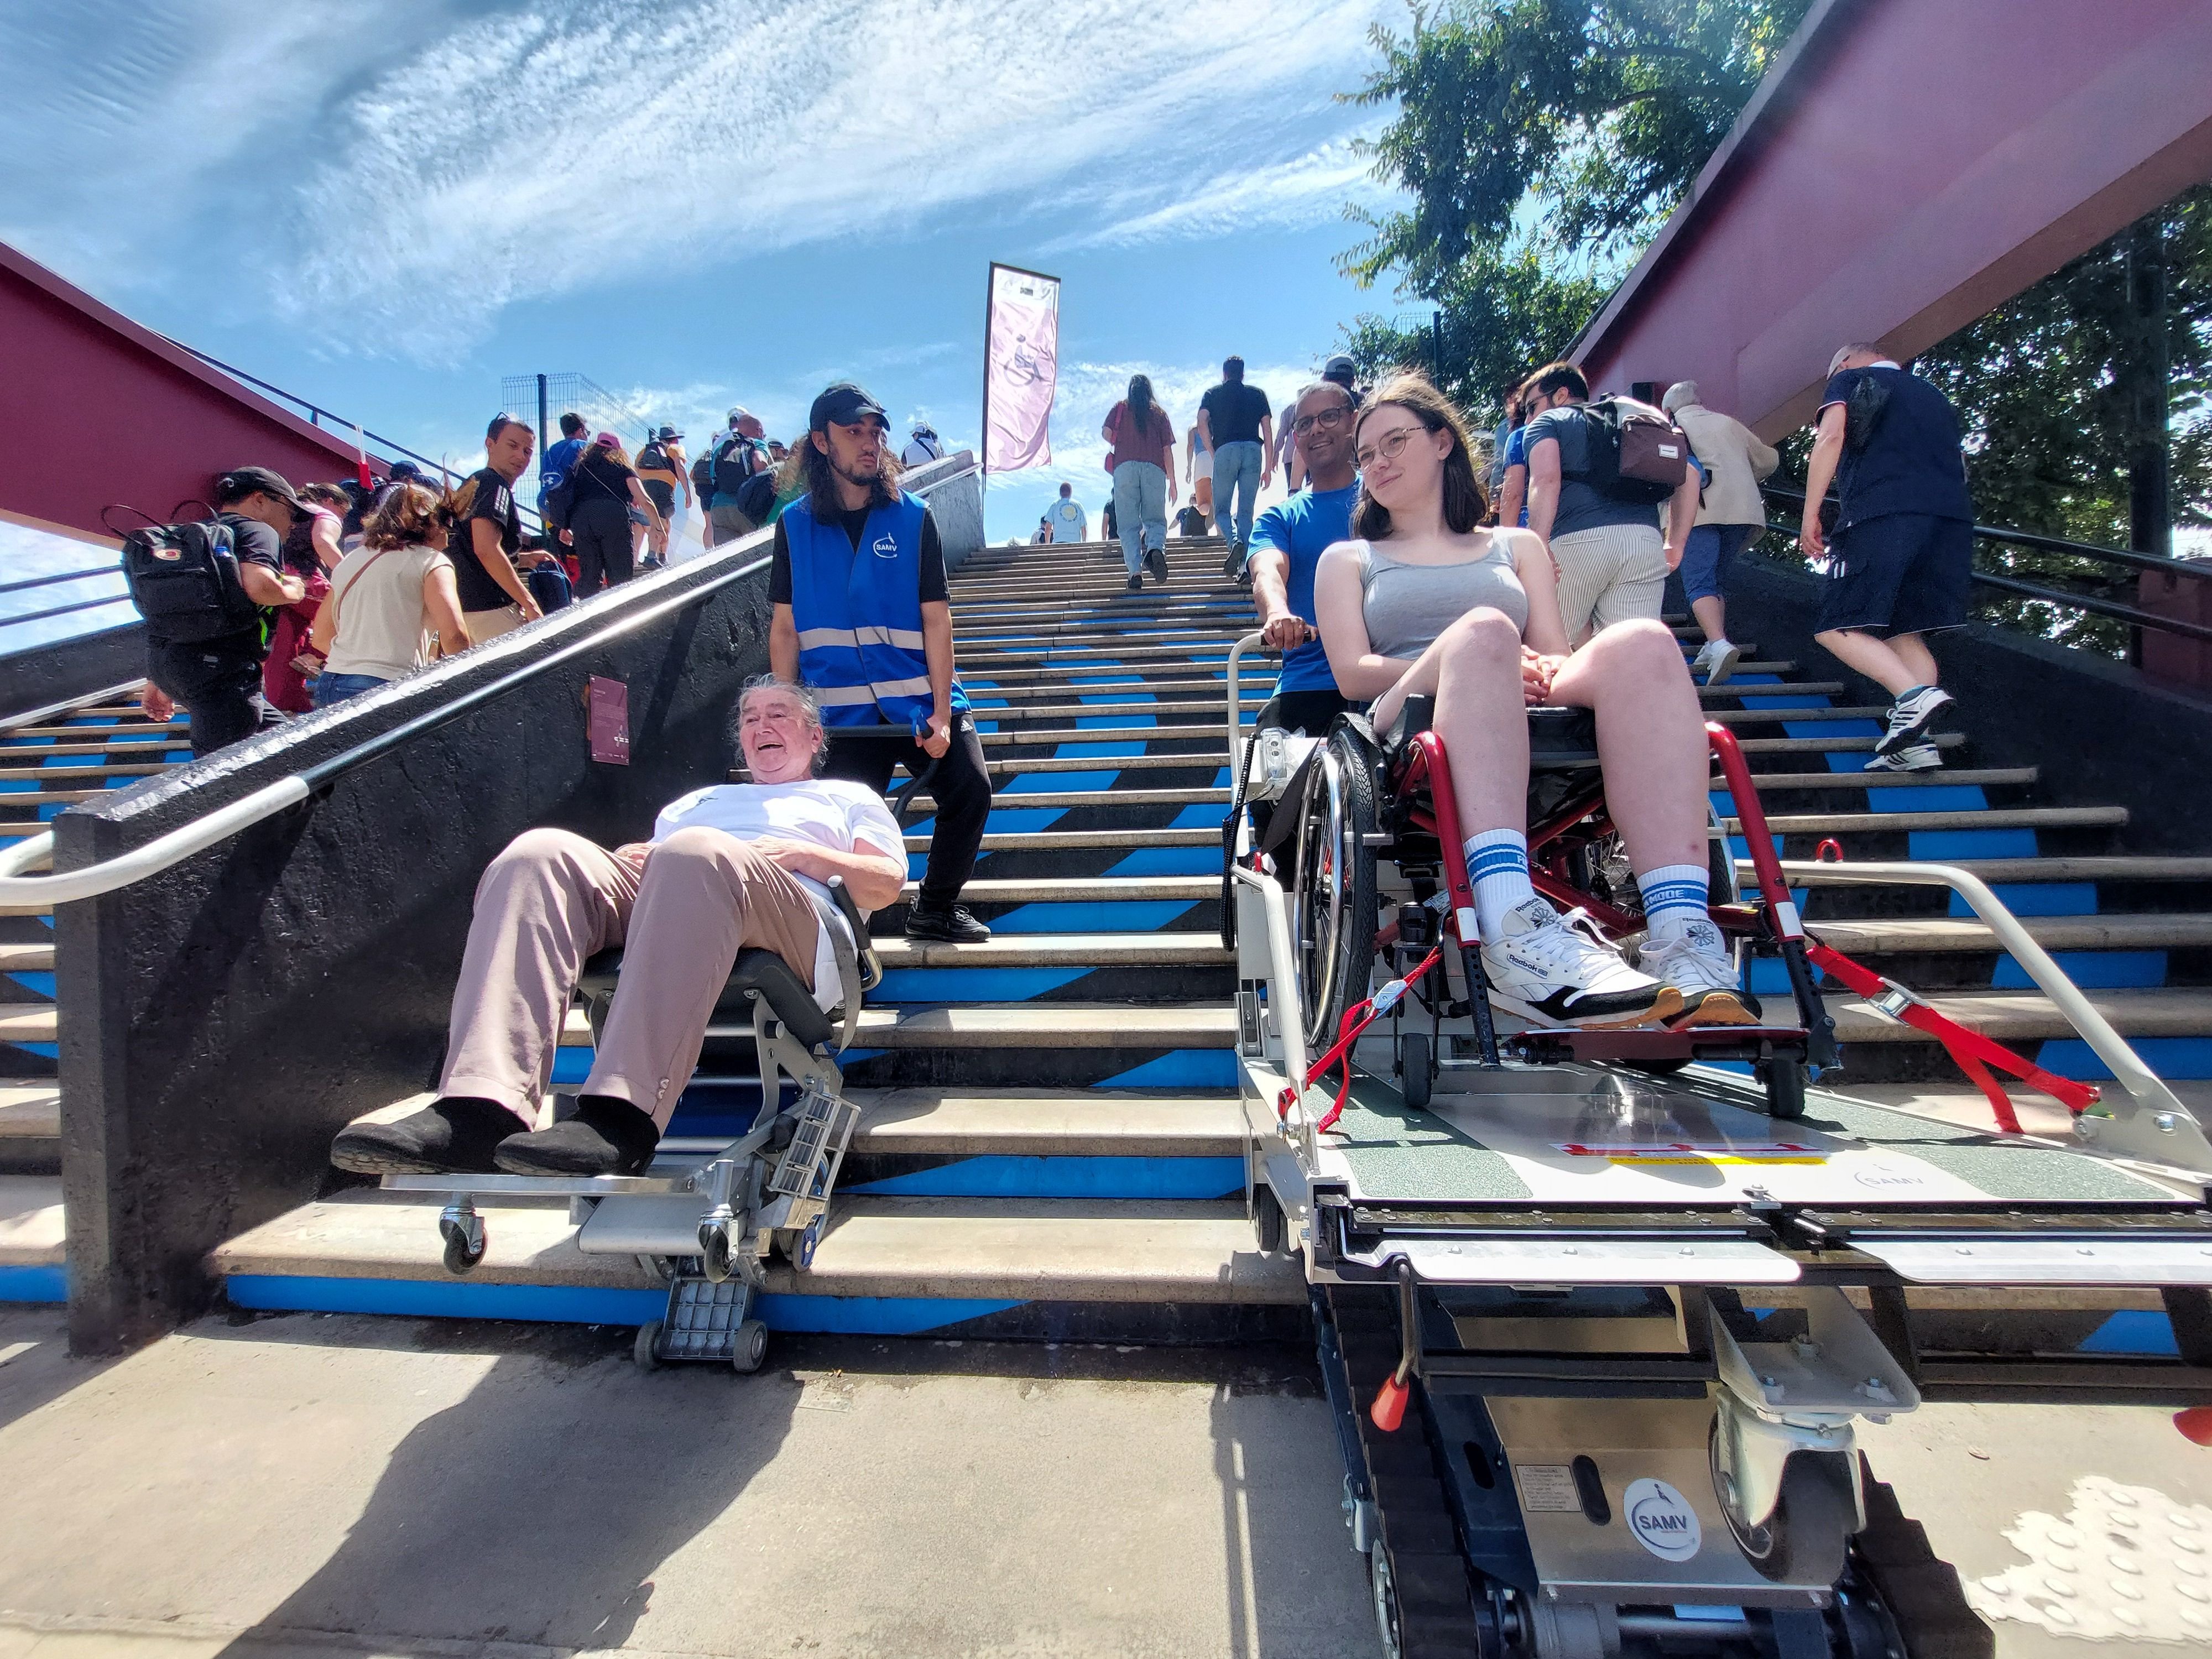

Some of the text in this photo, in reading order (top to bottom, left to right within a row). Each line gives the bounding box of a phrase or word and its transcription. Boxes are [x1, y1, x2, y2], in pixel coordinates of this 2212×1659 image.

[1649, 889, 1684, 904] MODE
[1515, 898, 1541, 912] Reebok
[1509, 954, 1537, 972] Reebok
[1639, 1515, 1687, 1530] SAMV
